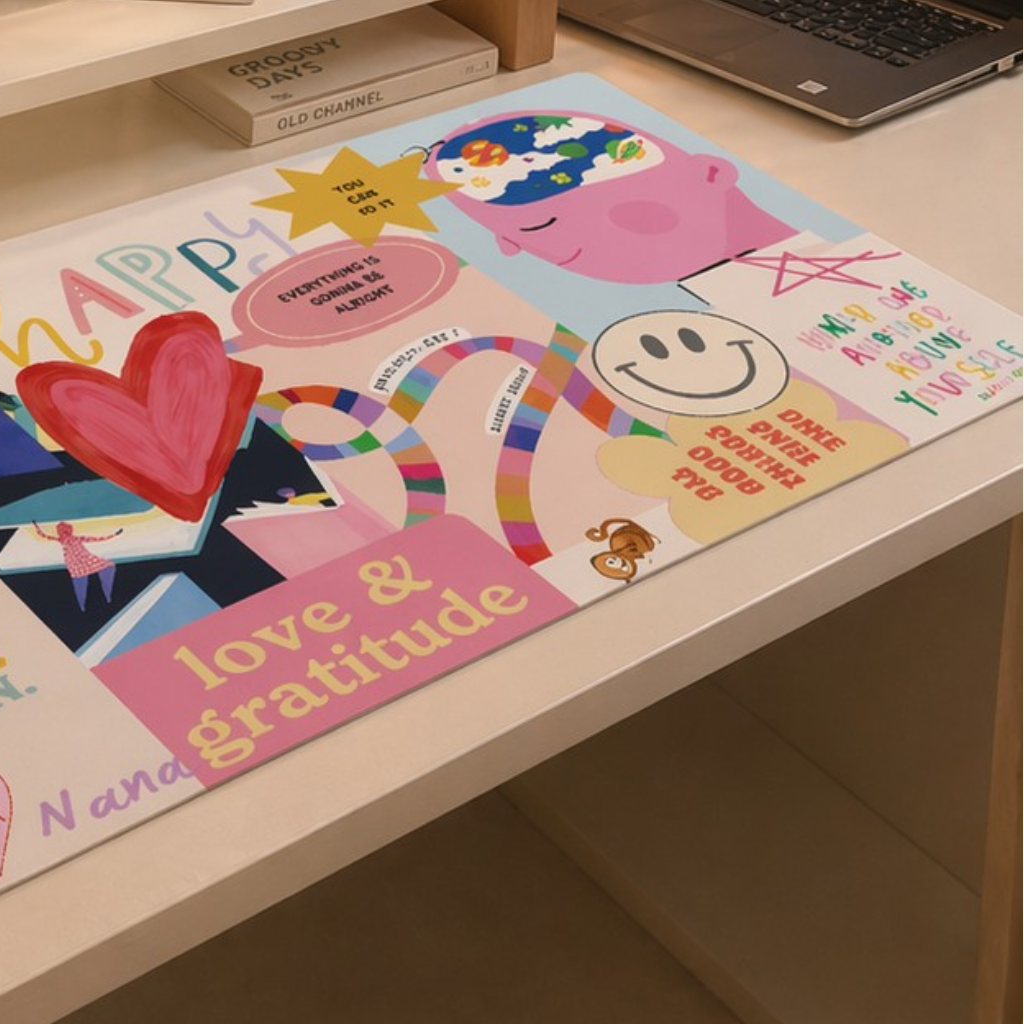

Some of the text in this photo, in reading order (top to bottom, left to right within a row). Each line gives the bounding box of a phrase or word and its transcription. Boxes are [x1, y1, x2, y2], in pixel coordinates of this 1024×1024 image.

[246, 61, 324, 90] DAYS
[278, 91, 385, 131] OLD CHANNEL
[173, 554, 433, 691] love &
[186, 584, 529, 771] gratitude
